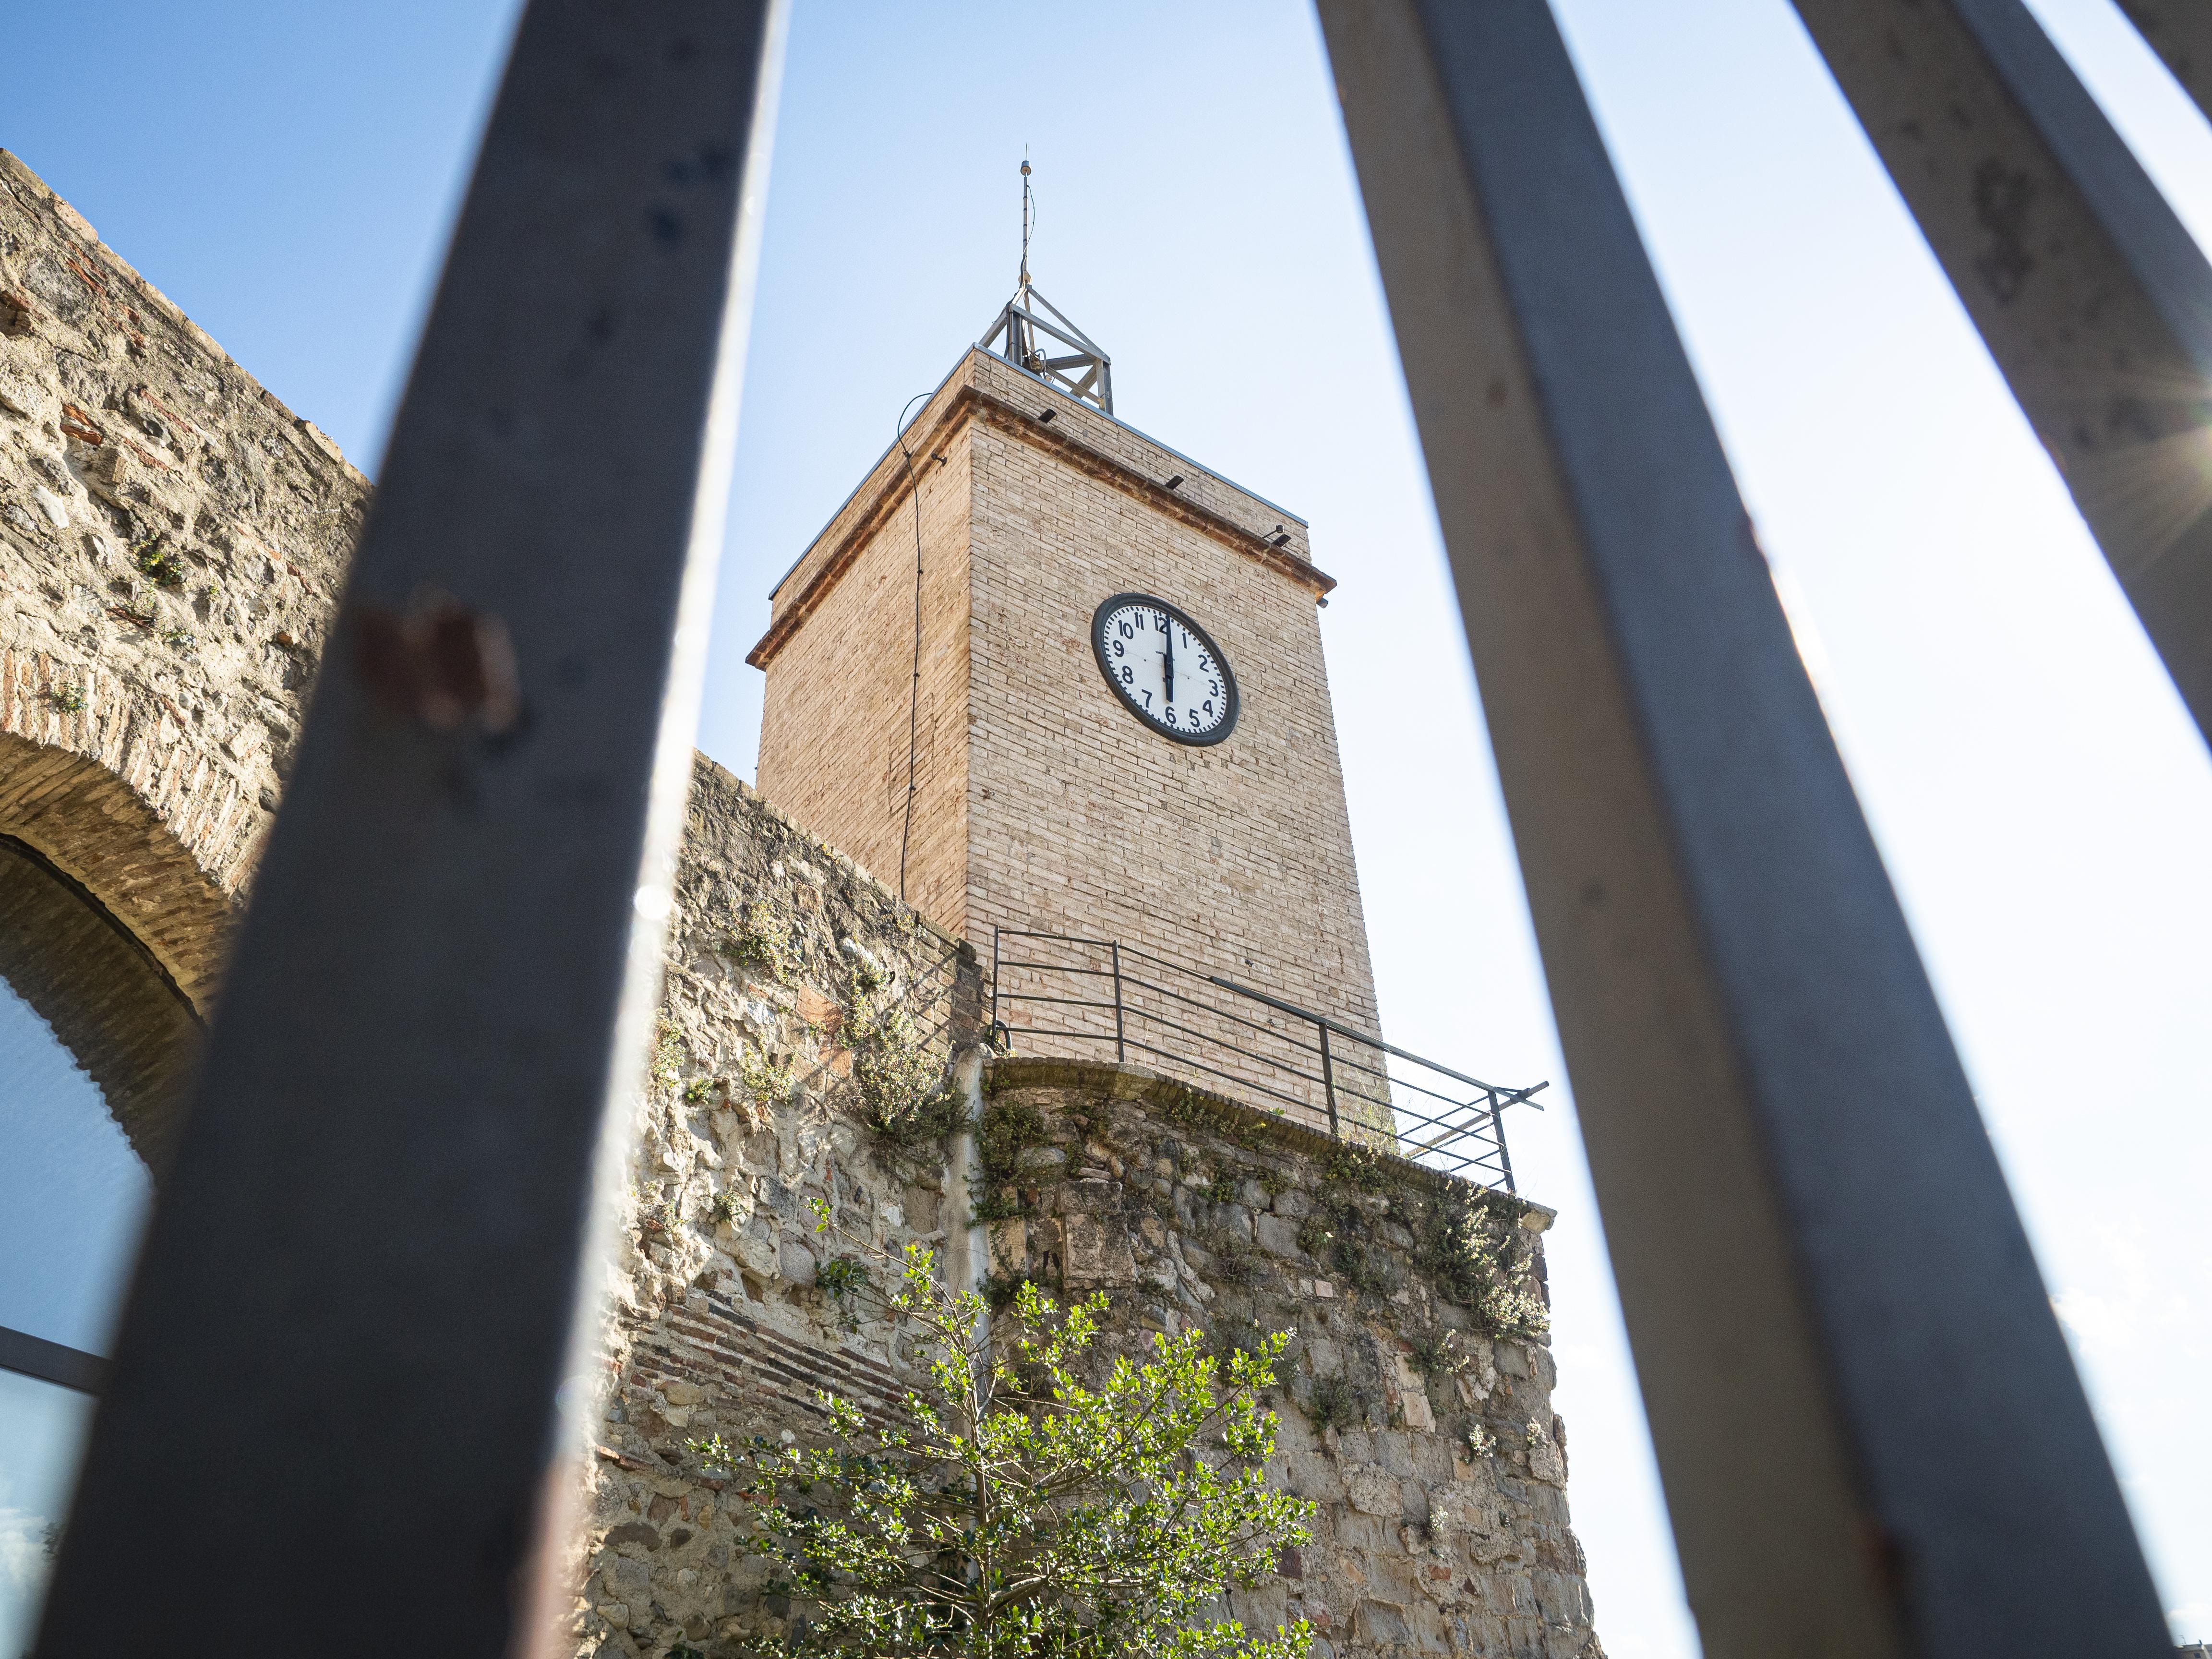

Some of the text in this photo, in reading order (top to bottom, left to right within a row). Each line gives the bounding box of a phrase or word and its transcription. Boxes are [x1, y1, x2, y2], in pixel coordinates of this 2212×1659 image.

[1118, 619, 1134, 640] 10
[1134, 612, 1144, 631] 11
[1153, 614, 1167, 635] 12
[1113, 640, 1125, 658] 9
[1182, 632, 1187, 649] 1
[1198, 654, 1209, 673] 2
[1122, 665, 1134, 685] 8
[1208, 679, 1219, 697] 3
[1141, 689, 1153, 709] 7
[1202, 699, 1214, 718] 4
[1165, 706, 1177, 724] 6
[1189, 708, 1200, 728] 5
